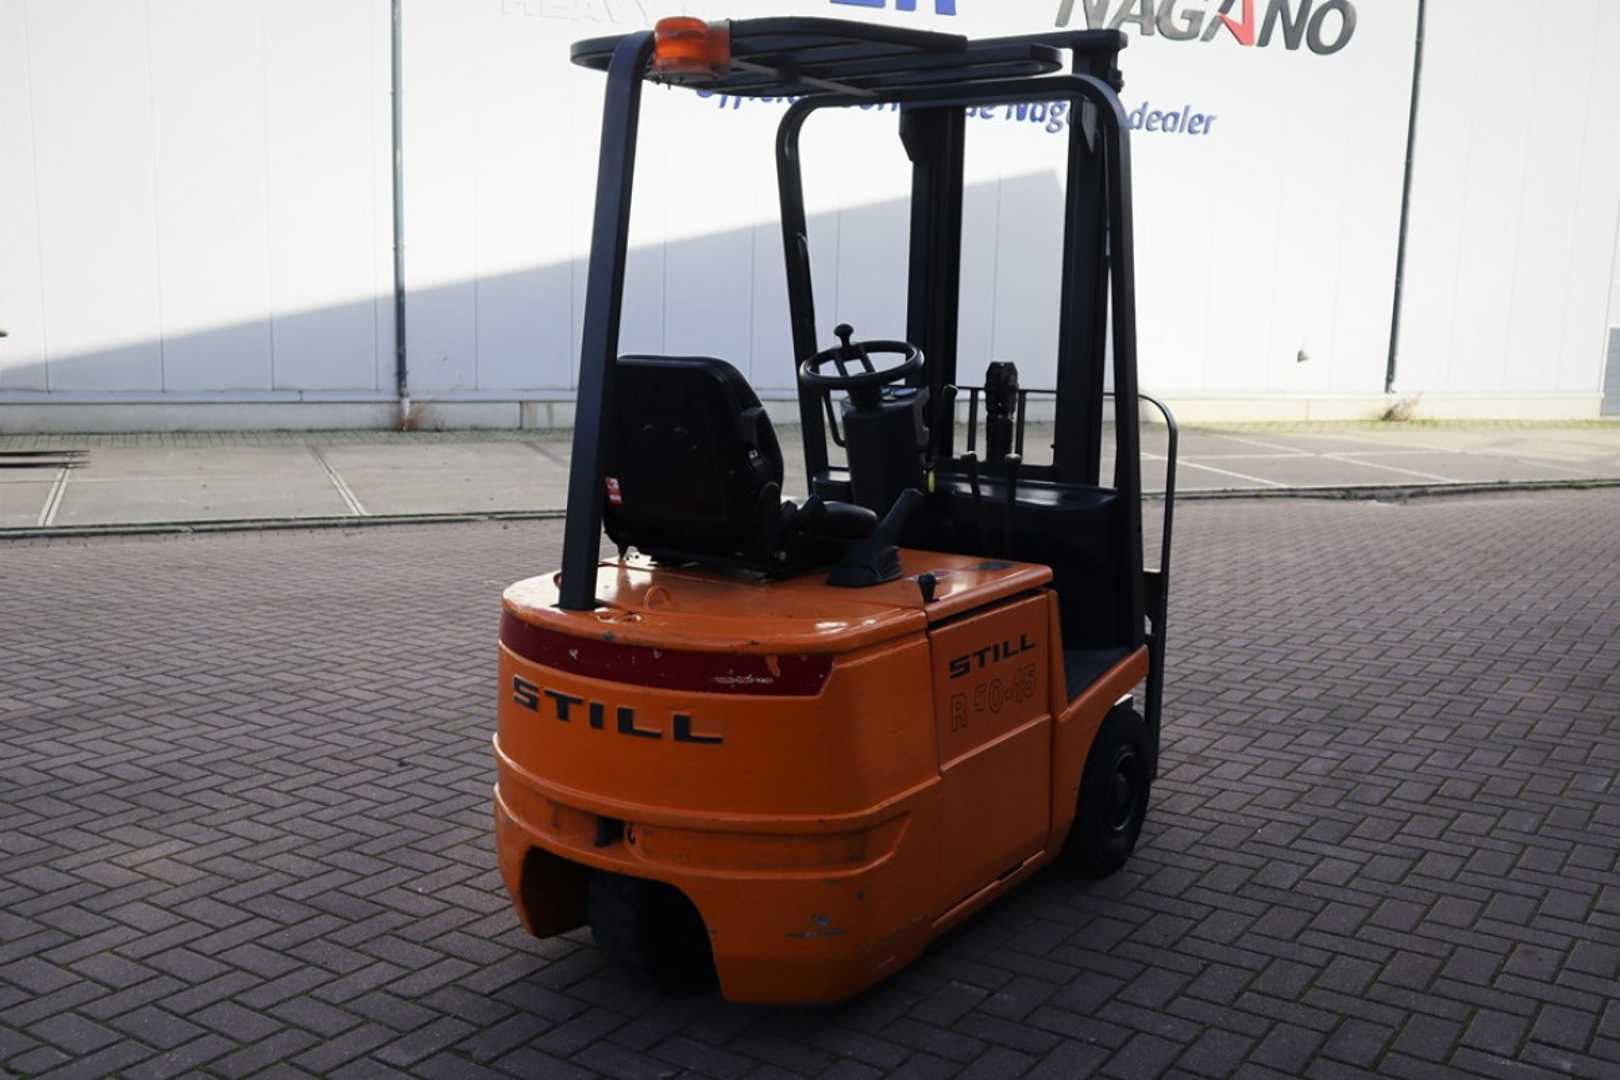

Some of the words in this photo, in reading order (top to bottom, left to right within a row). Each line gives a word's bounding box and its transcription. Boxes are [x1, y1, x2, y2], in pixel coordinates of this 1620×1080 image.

[1055, 0, 1357, 56] NAGANO
[1128, 101, 1217, 135] dealer
[948, 633, 1036, 679] STILL
[512, 673, 724, 745] STILL
